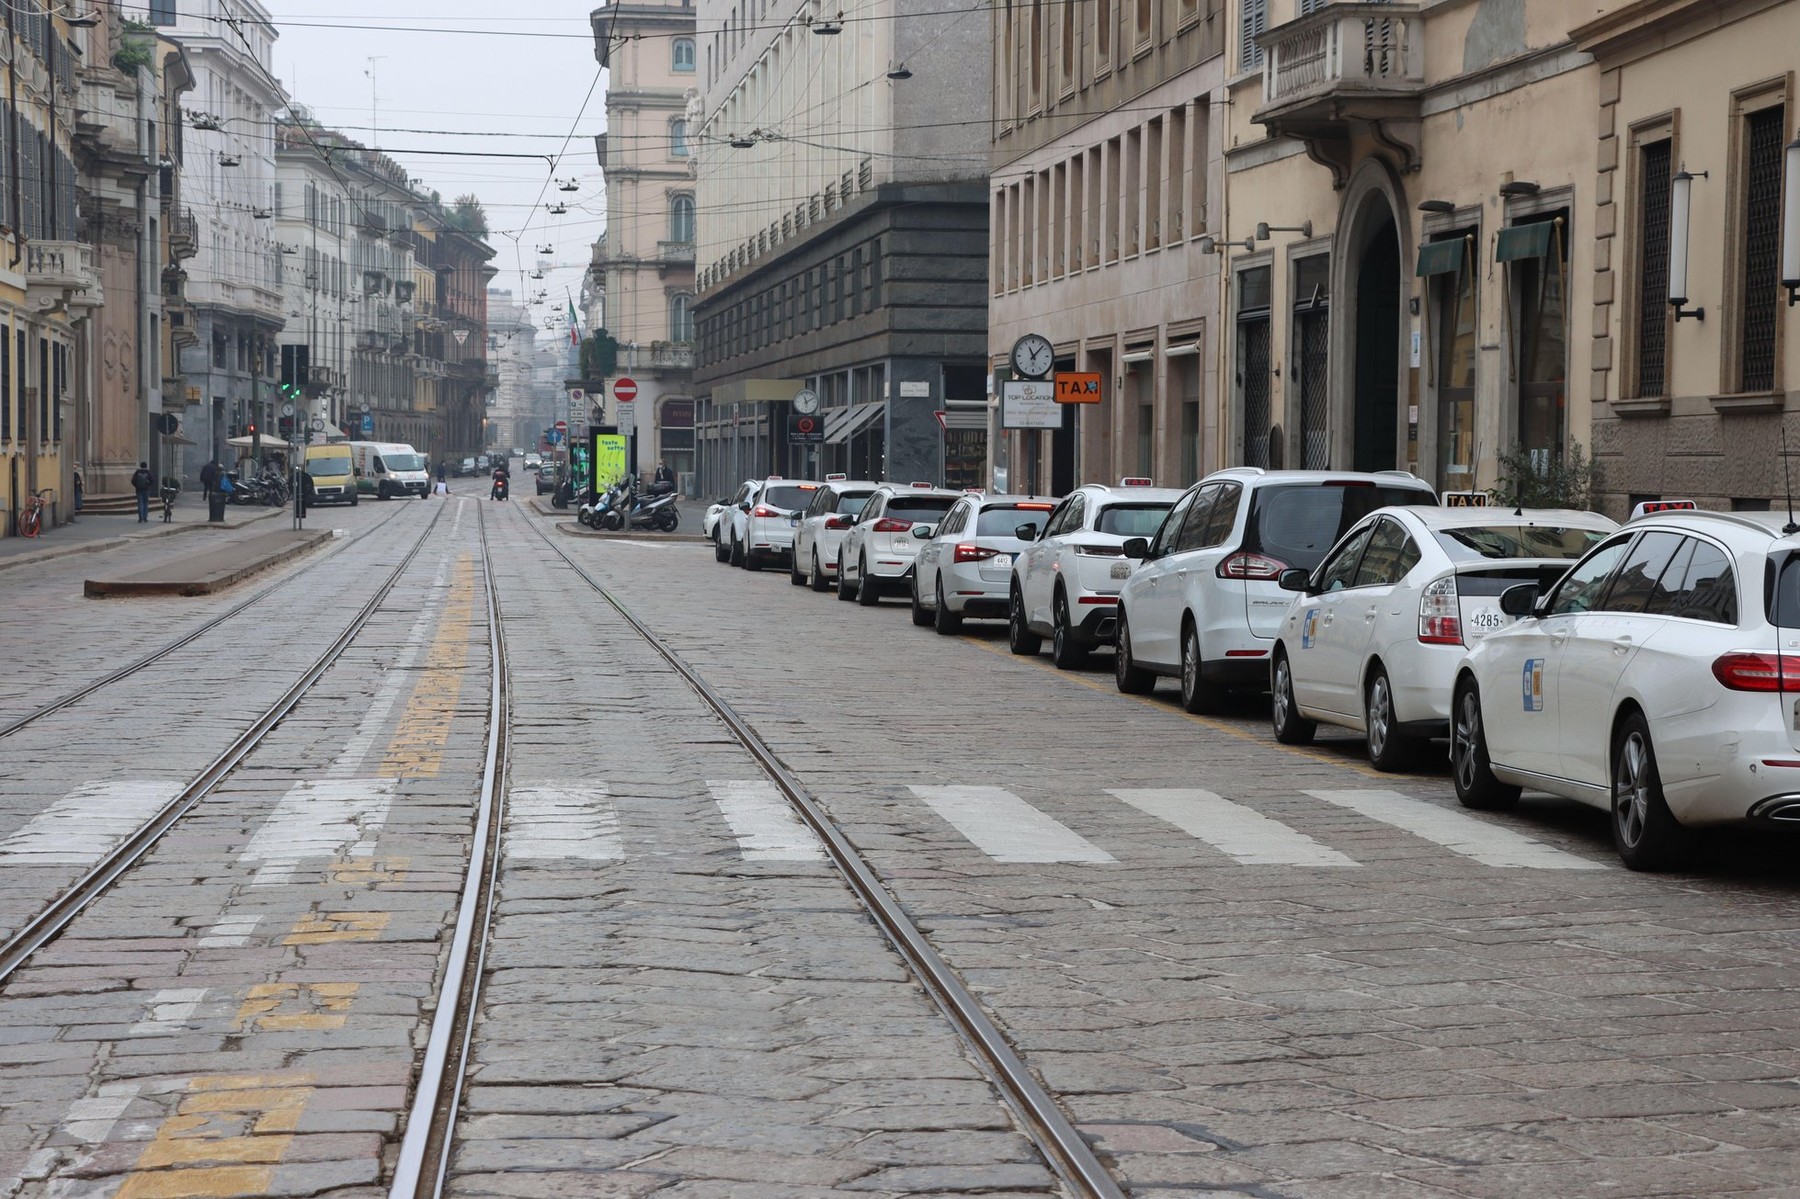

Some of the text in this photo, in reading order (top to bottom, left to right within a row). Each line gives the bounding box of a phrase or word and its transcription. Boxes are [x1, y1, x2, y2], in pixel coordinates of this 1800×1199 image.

[1058, 381, 1098, 395] TAXI
[1449, 495, 1484, 508] TAXI
[1645, 503, 1692, 512] TAXI
[1473, 614, 1499, 627] 4285
